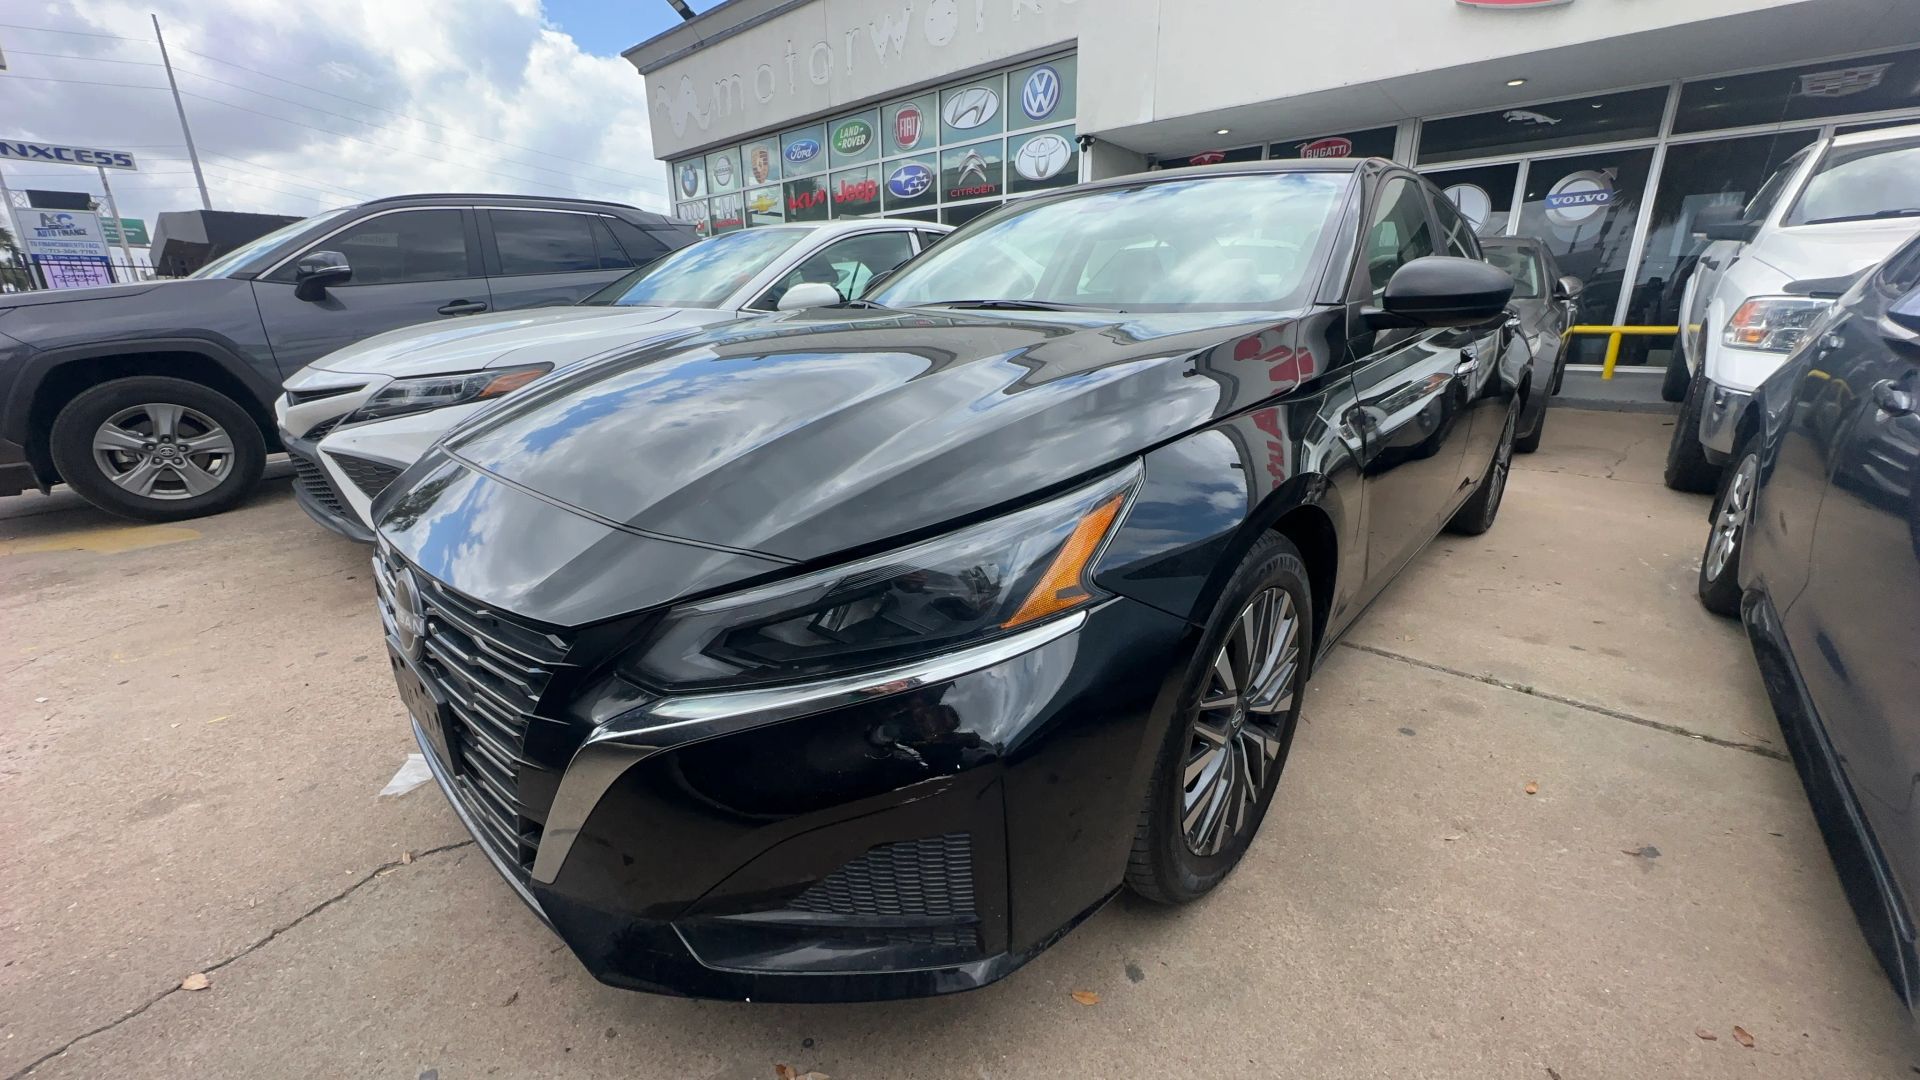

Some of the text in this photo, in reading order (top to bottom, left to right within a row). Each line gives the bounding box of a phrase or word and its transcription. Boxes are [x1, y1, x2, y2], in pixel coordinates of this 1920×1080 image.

[840, 125, 859, 138] LAND
[900, 116, 917, 138] FIAT
[842, 135, 866, 149] ROVER
[0, 142, 132, 167] NXCESS
[791, 143, 812, 160] Ford
[1307, 145, 1347, 159] BUGATTI
[835, 180, 877, 204] Jeep
[1551, 193, 1608, 205] VOLVO
[37, 228, 88, 237] AUTO FINANCE
